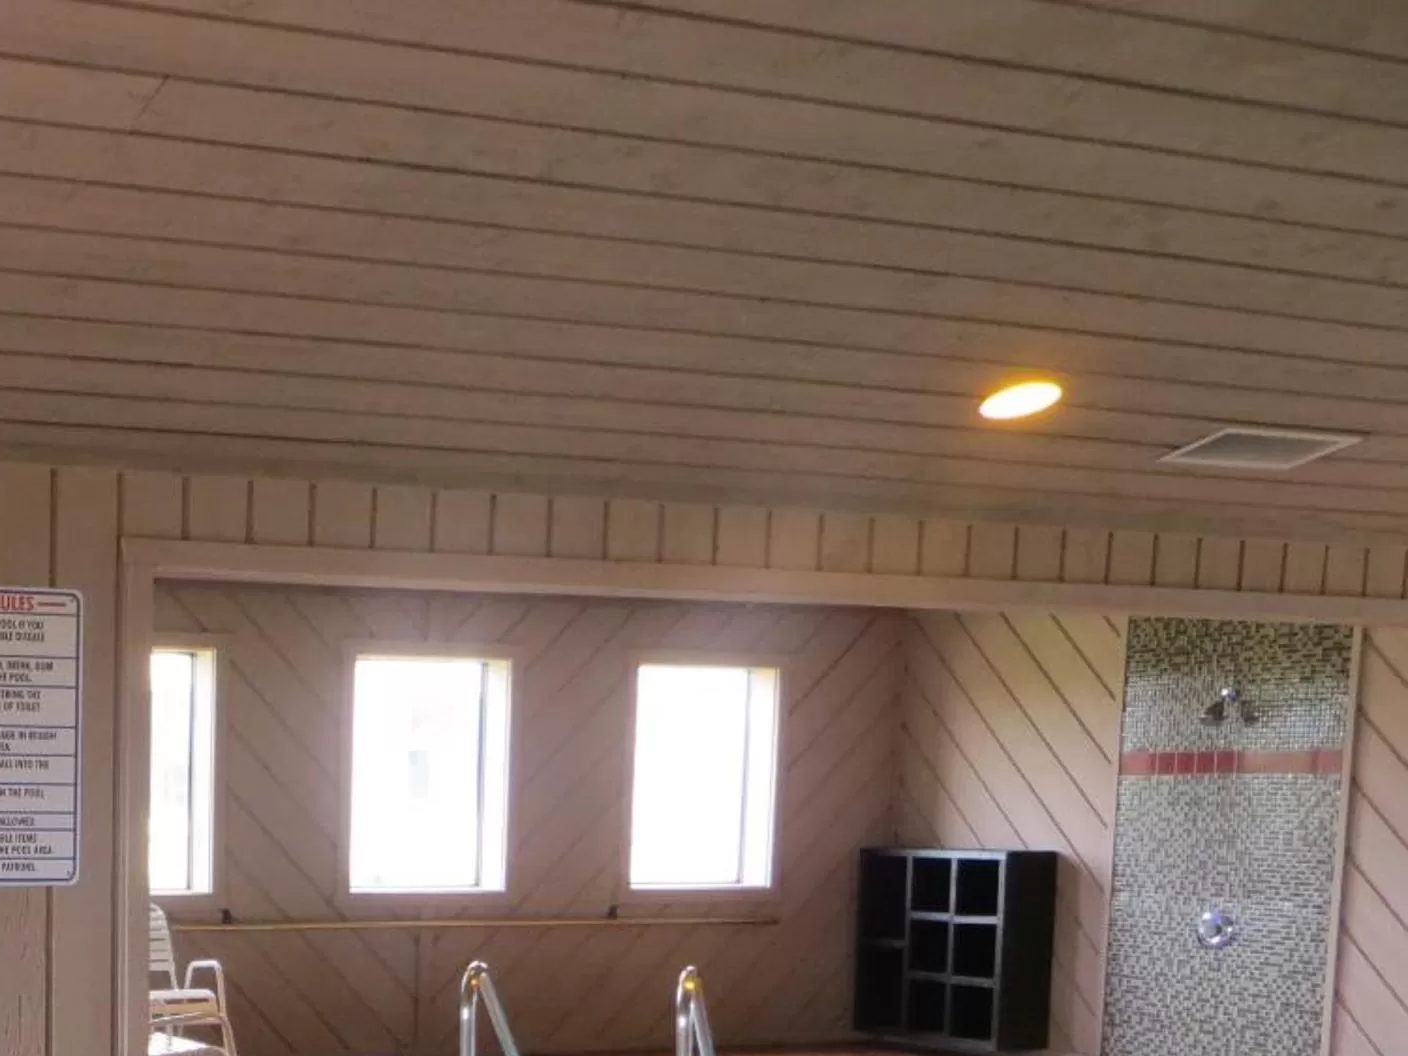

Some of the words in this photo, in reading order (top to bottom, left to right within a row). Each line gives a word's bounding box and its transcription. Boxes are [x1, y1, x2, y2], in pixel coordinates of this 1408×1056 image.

[27, 621, 44, 629] YOU
[3, 703, 13, 711] OF
[15, 760, 33, 769] INTO
[35, 760, 49, 769] THE
[8, 789, 21, 797] THE
[11, 846, 30, 854] POOL
